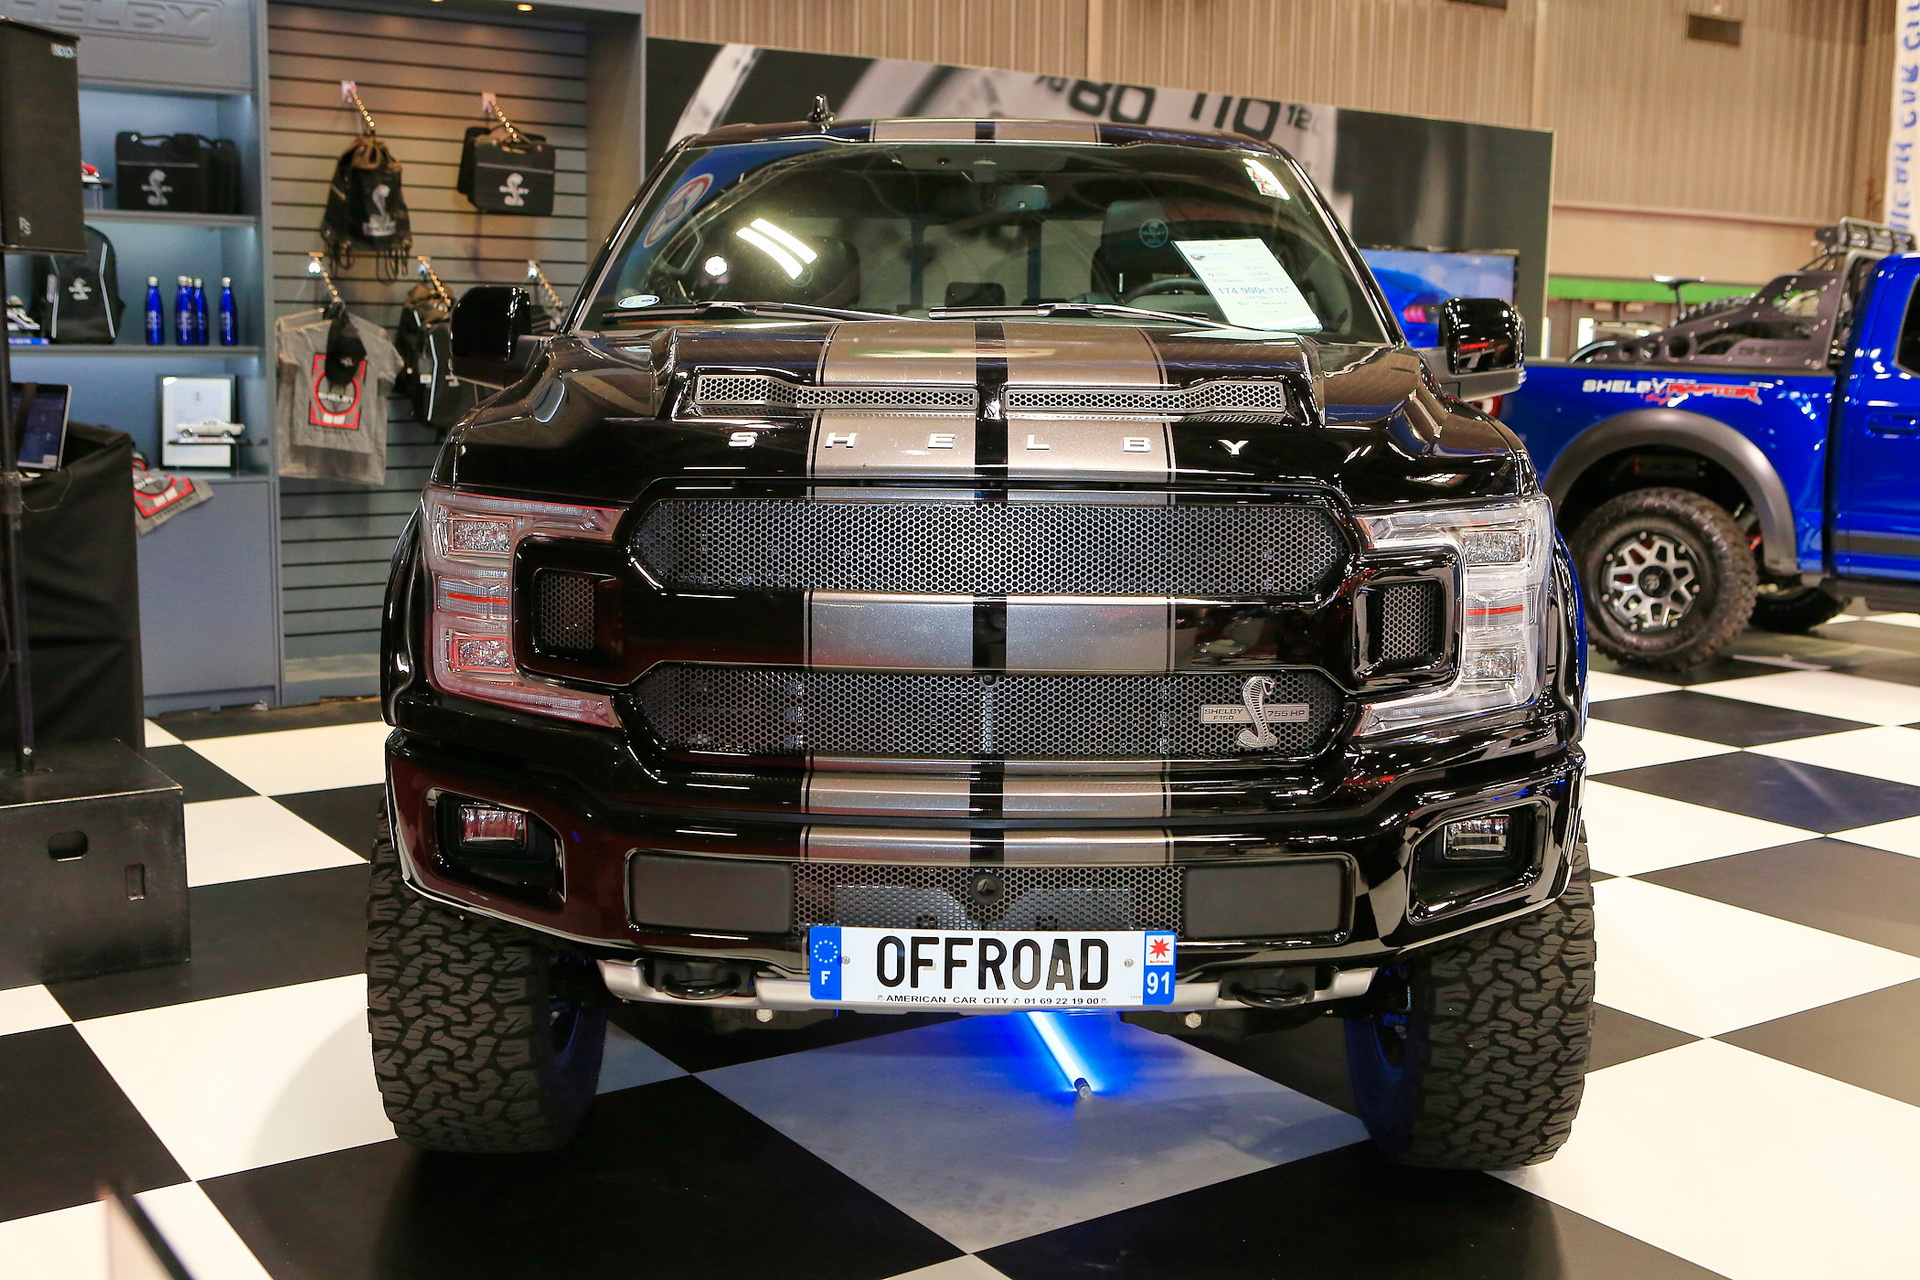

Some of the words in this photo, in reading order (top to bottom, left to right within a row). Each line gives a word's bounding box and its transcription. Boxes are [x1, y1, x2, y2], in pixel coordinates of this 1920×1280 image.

[1217, 287, 1239, 295] 174
[1582, 378, 1669, 394] SHELBY
[1667, 383, 1763, 405] RAPTOR
[728, 430, 1249, 457] SHELBY
[876, 935, 1109, 990] OFFROAD
[821, 971, 831, 985] F
[1146, 971, 1170, 995] 91
[885, 994, 946, 1004] AMERICAN
[953, 996, 977, 1004] CAR
[1024, 997, 1036, 1005] 01
[1040, 997, 1053, 1005] 69
[1055, 997, 1068, 1005] 22
[1072, 997, 1084, 1005] 19
[1086, 997, 1099, 1005] 00
